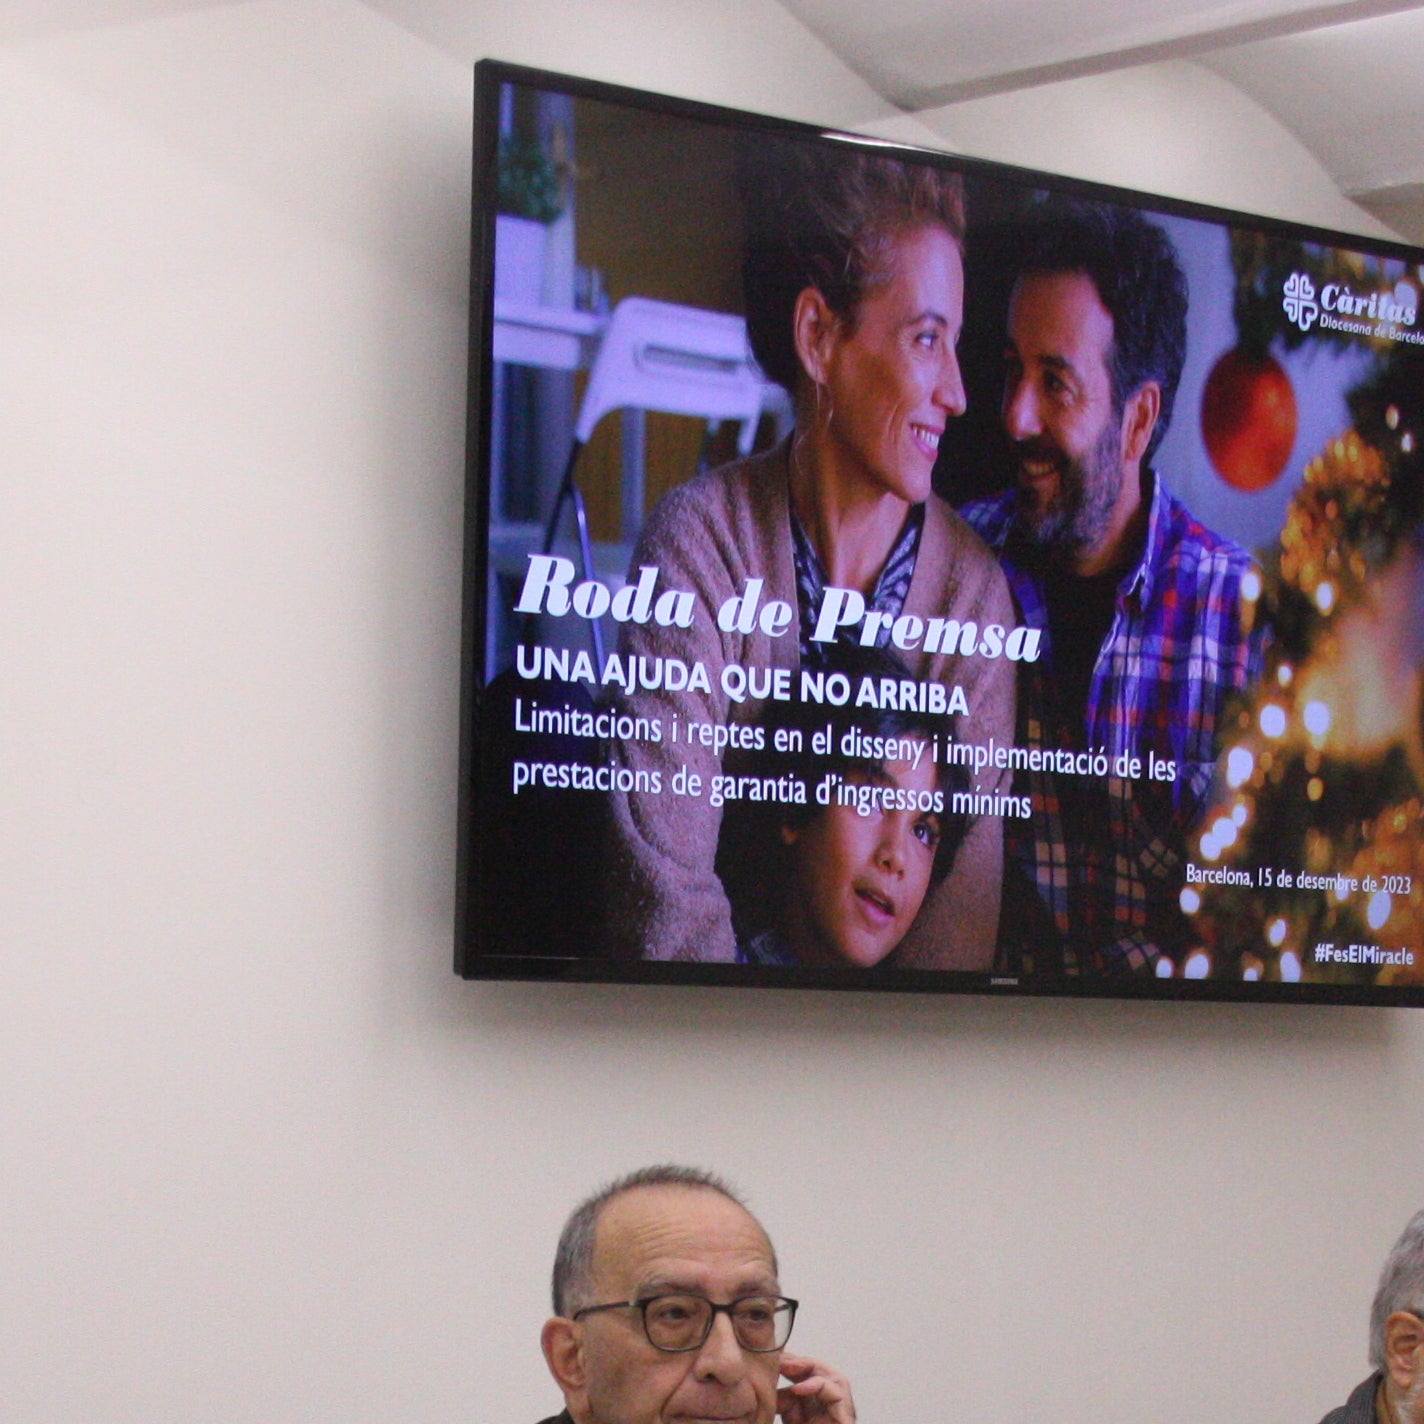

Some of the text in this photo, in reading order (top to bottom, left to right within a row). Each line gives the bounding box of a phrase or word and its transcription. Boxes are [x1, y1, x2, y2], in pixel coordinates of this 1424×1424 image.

[1320, 314, 1372, 337] Diocesana
[1374, 324, 1387, 338] de
[1321, 284, 1417, 326] Càritas
[513, 554, 1042, 663] Roda de Premsa
[516, 644, 969, 716] UNA AJUDA QUE NO ARRIBA
[514, 698, 1177, 783] Limitacions i reptes en el disseny i implementació de les
[513, 760, 662, 795] prestacions
[671, 764, 702, 797] de
[709, 773, 807, 808] garantia
[951, 785, 1032, 819] mínims
[1186, 863, 1412, 894] Barcelona, 15 de desembre de 2023
[1314, 943, 1414, 966] #FesElMiracle
